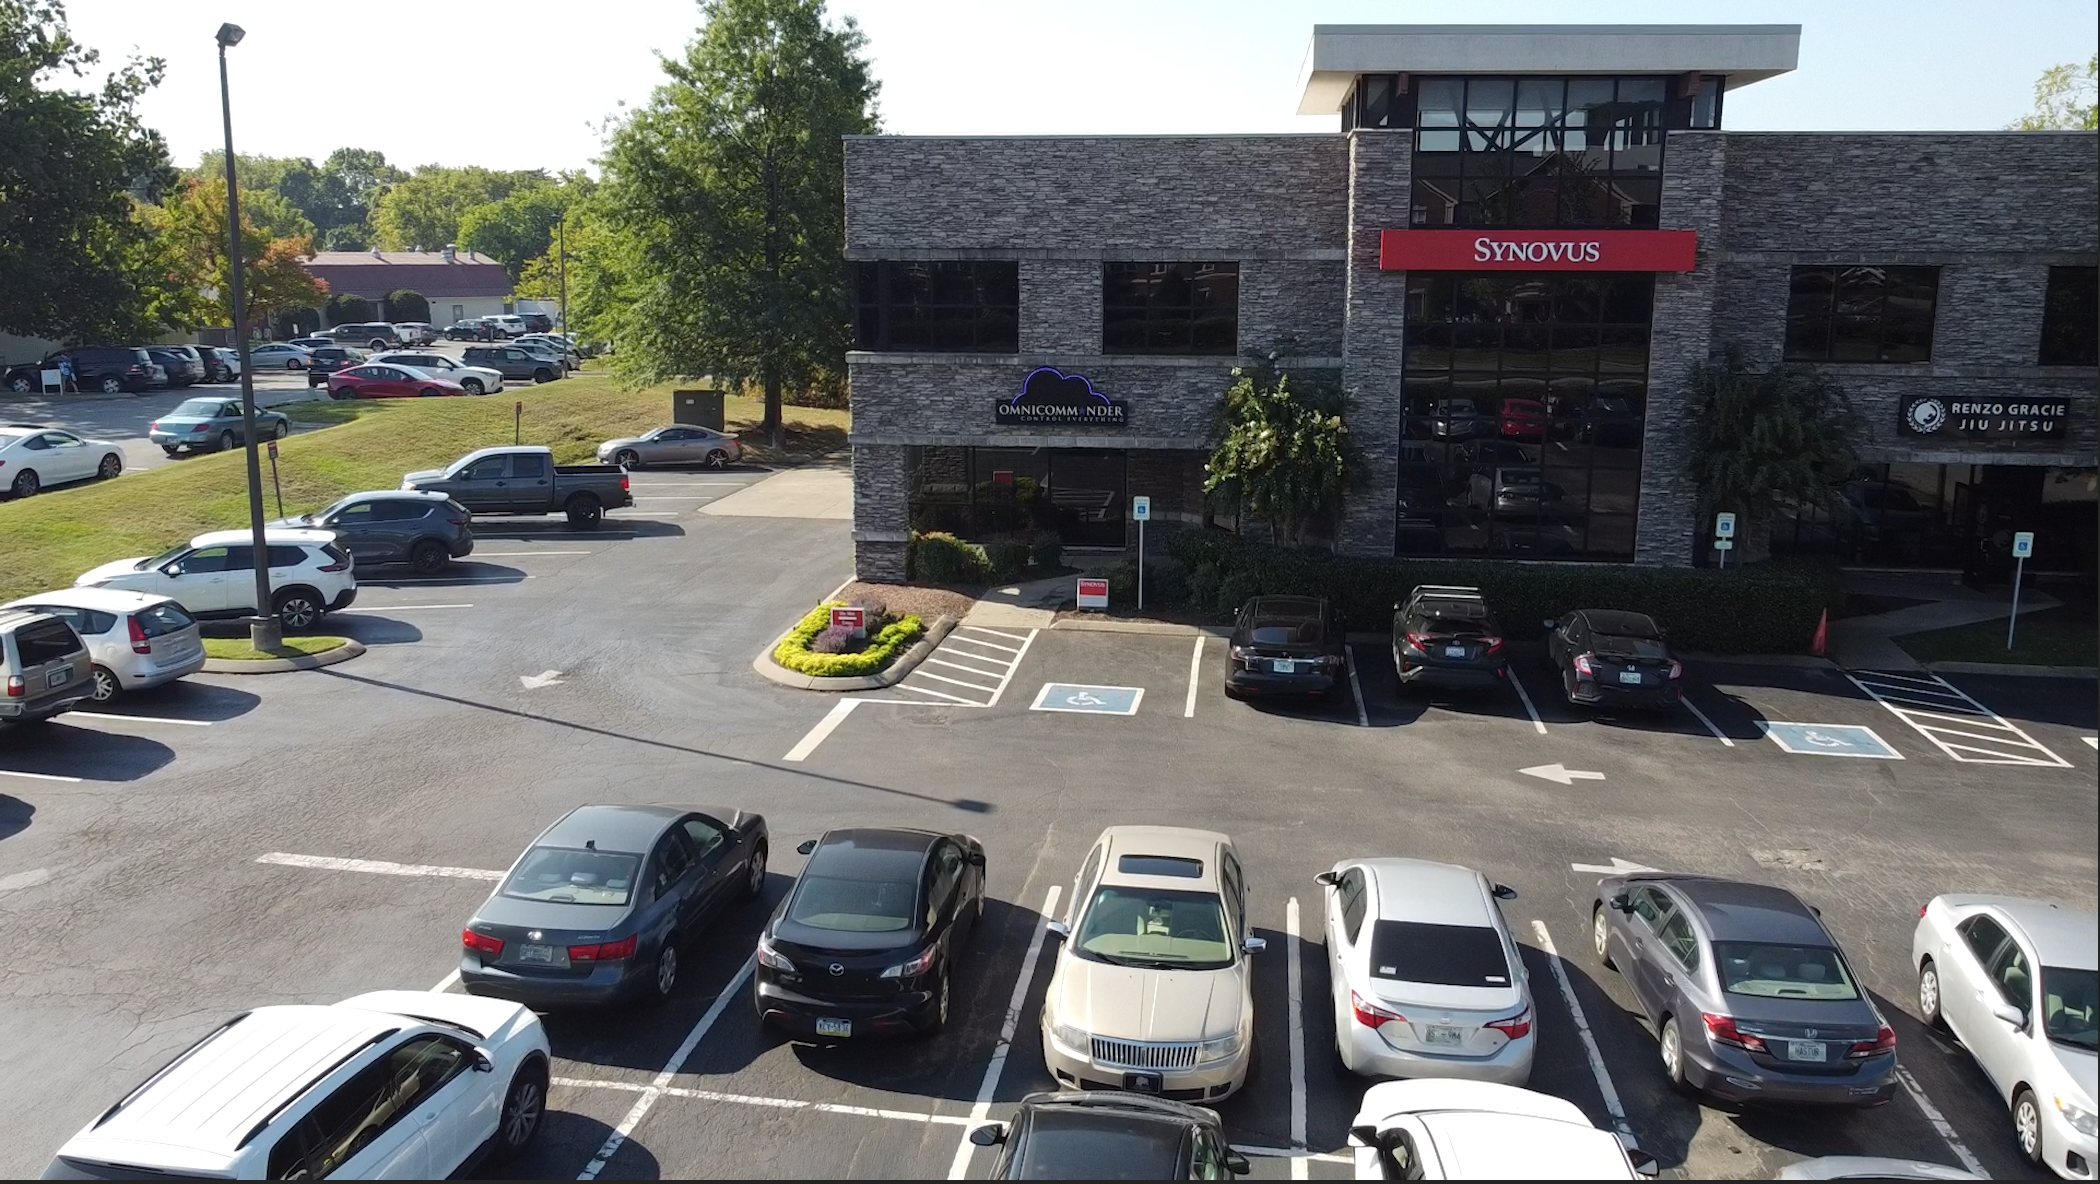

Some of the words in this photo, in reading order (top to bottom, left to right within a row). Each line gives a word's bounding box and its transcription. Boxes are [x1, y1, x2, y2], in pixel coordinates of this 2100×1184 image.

[1473, 237, 1600, 263] SYNOVUS
[1951, 402, 2004, 415] RENZO
[2008, 404, 2066, 417] GRACIE
[1958, 418, 1989, 431] JIU
[1998, 420, 2055, 432] JITSU
